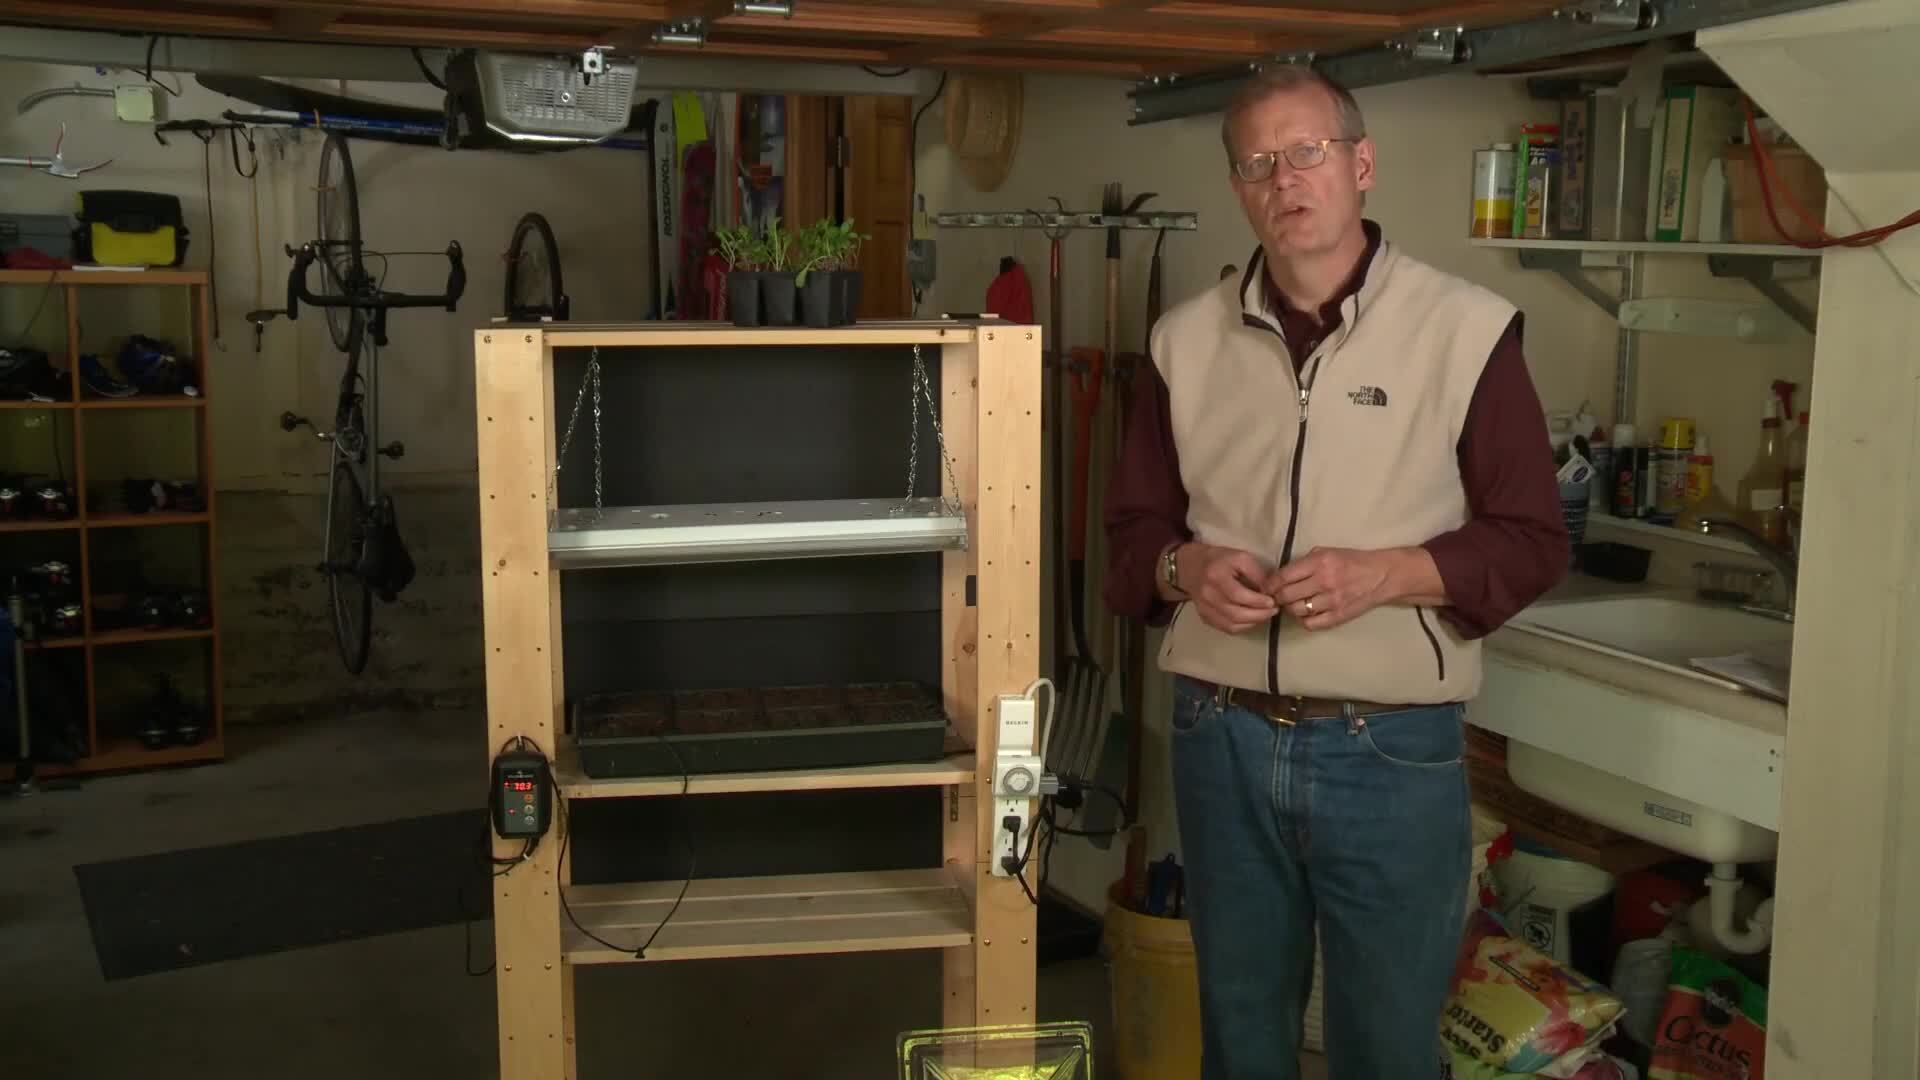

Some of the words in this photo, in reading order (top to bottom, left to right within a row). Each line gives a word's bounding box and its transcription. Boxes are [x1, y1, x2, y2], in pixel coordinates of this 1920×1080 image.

[661, 158, 673, 237] ROSSIGNOL
[1360, 385, 1374, 393] THE
[1347, 391, 1374, 399] NORTH
[1352, 398, 1373, 406] FACE
[1664, 1015, 1752, 1067] Cactus
